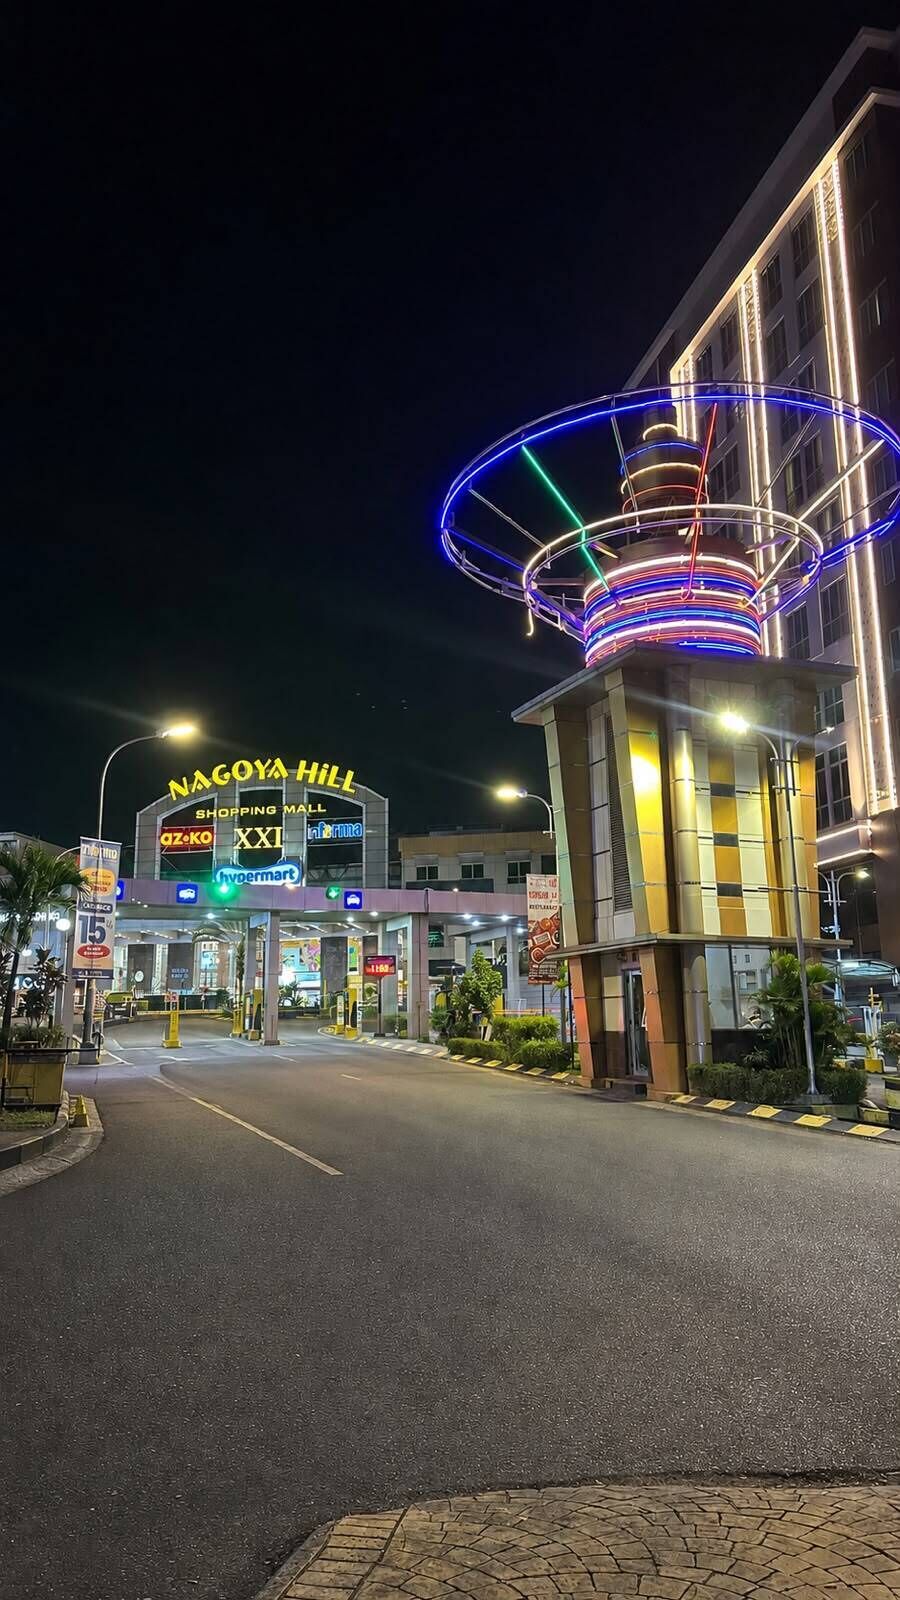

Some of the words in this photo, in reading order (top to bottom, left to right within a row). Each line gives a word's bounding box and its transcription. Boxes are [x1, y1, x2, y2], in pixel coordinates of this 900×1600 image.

[167, 757, 289, 801] NAGOYA
[195, 805, 277, 819] SHOPPING
[283, 803, 327, 814] MALL
[233, 826, 284, 850] XXI
[219, 867, 296, 884] hypermart
